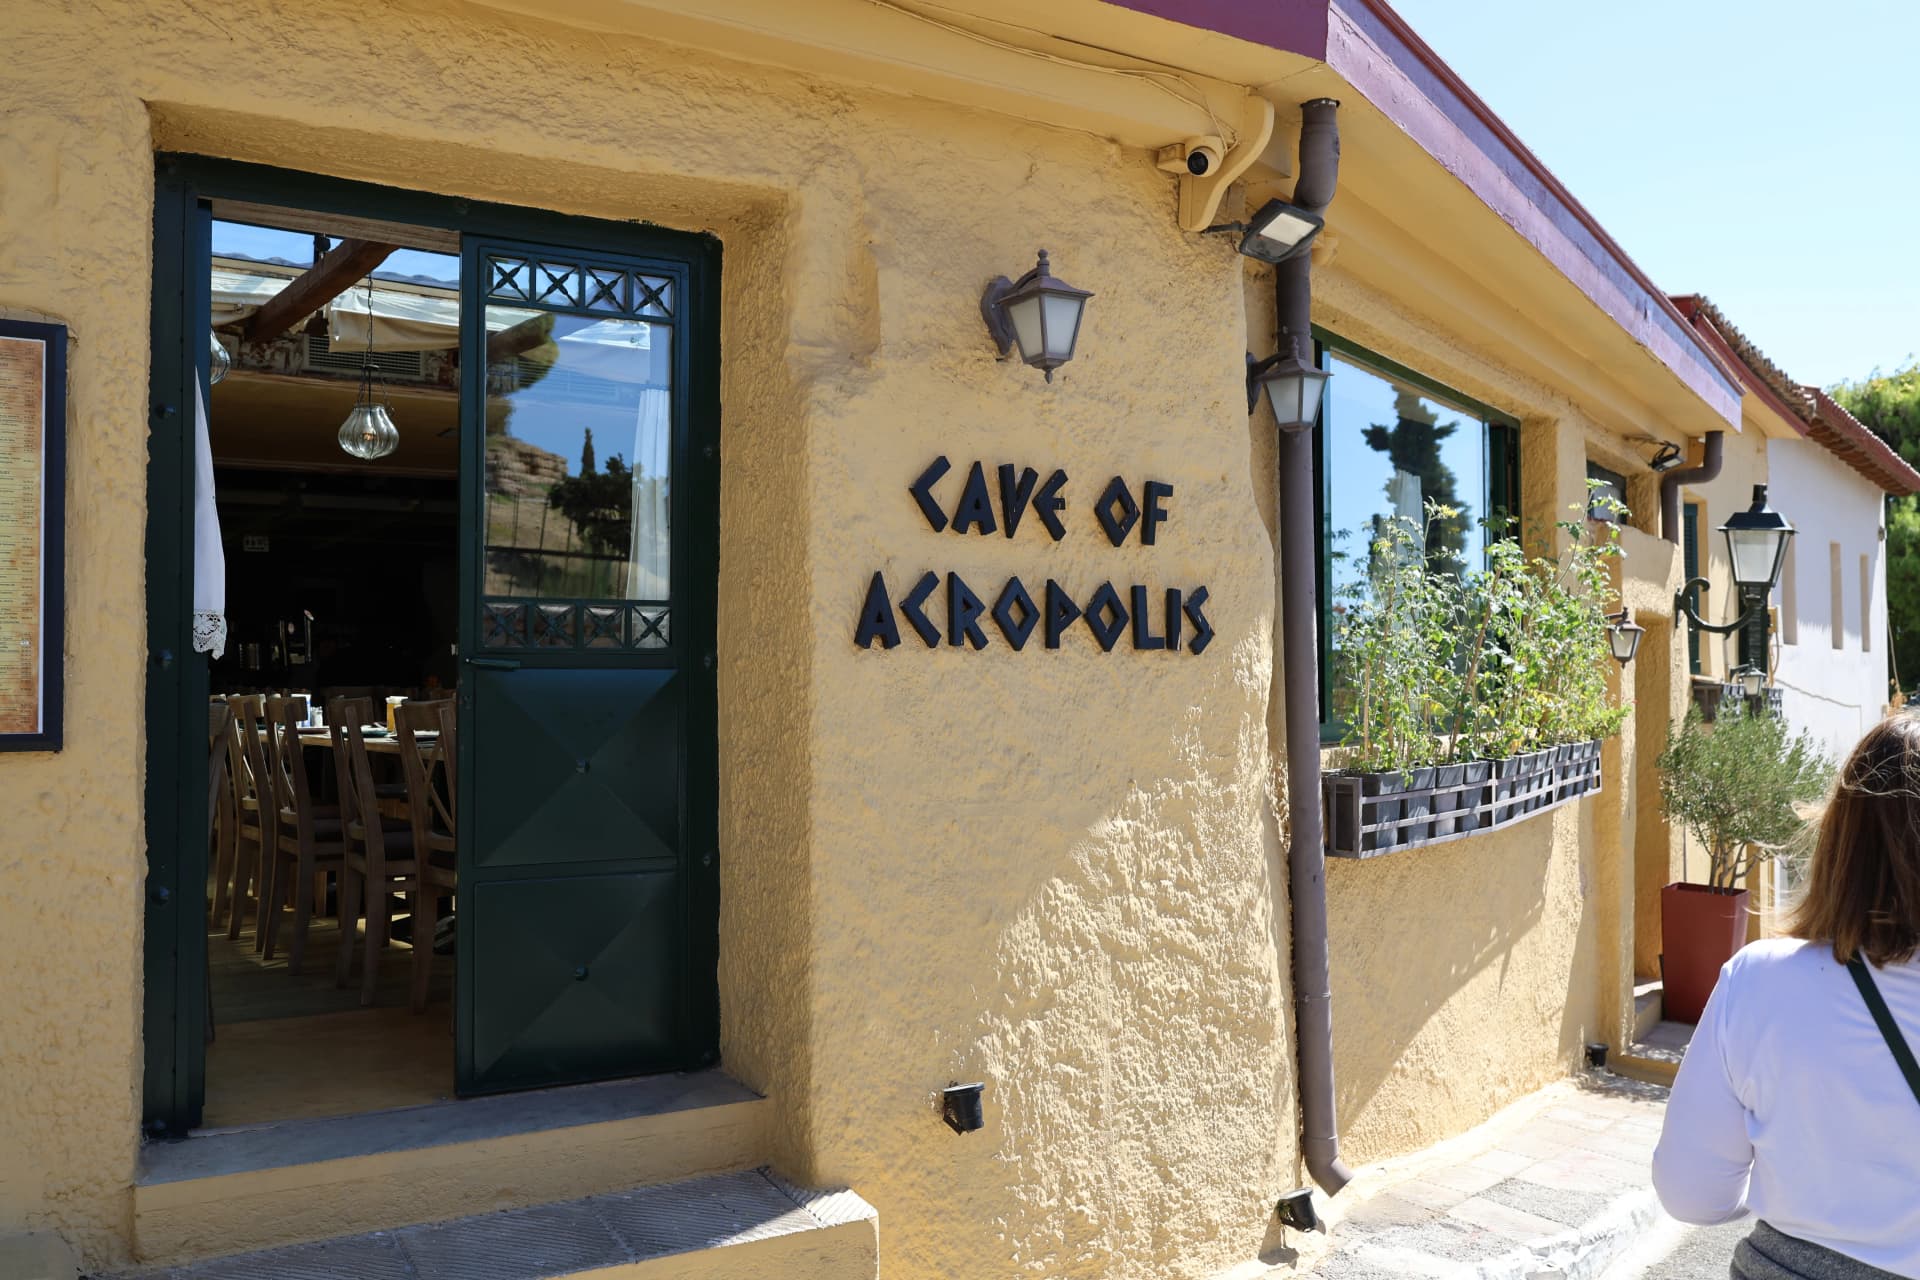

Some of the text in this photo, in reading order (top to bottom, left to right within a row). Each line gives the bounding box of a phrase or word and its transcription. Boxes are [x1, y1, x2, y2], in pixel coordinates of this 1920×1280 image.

[908, 456, 1173, 547] CAVE OF
[854, 571, 1215, 655] ACROPOLIS
